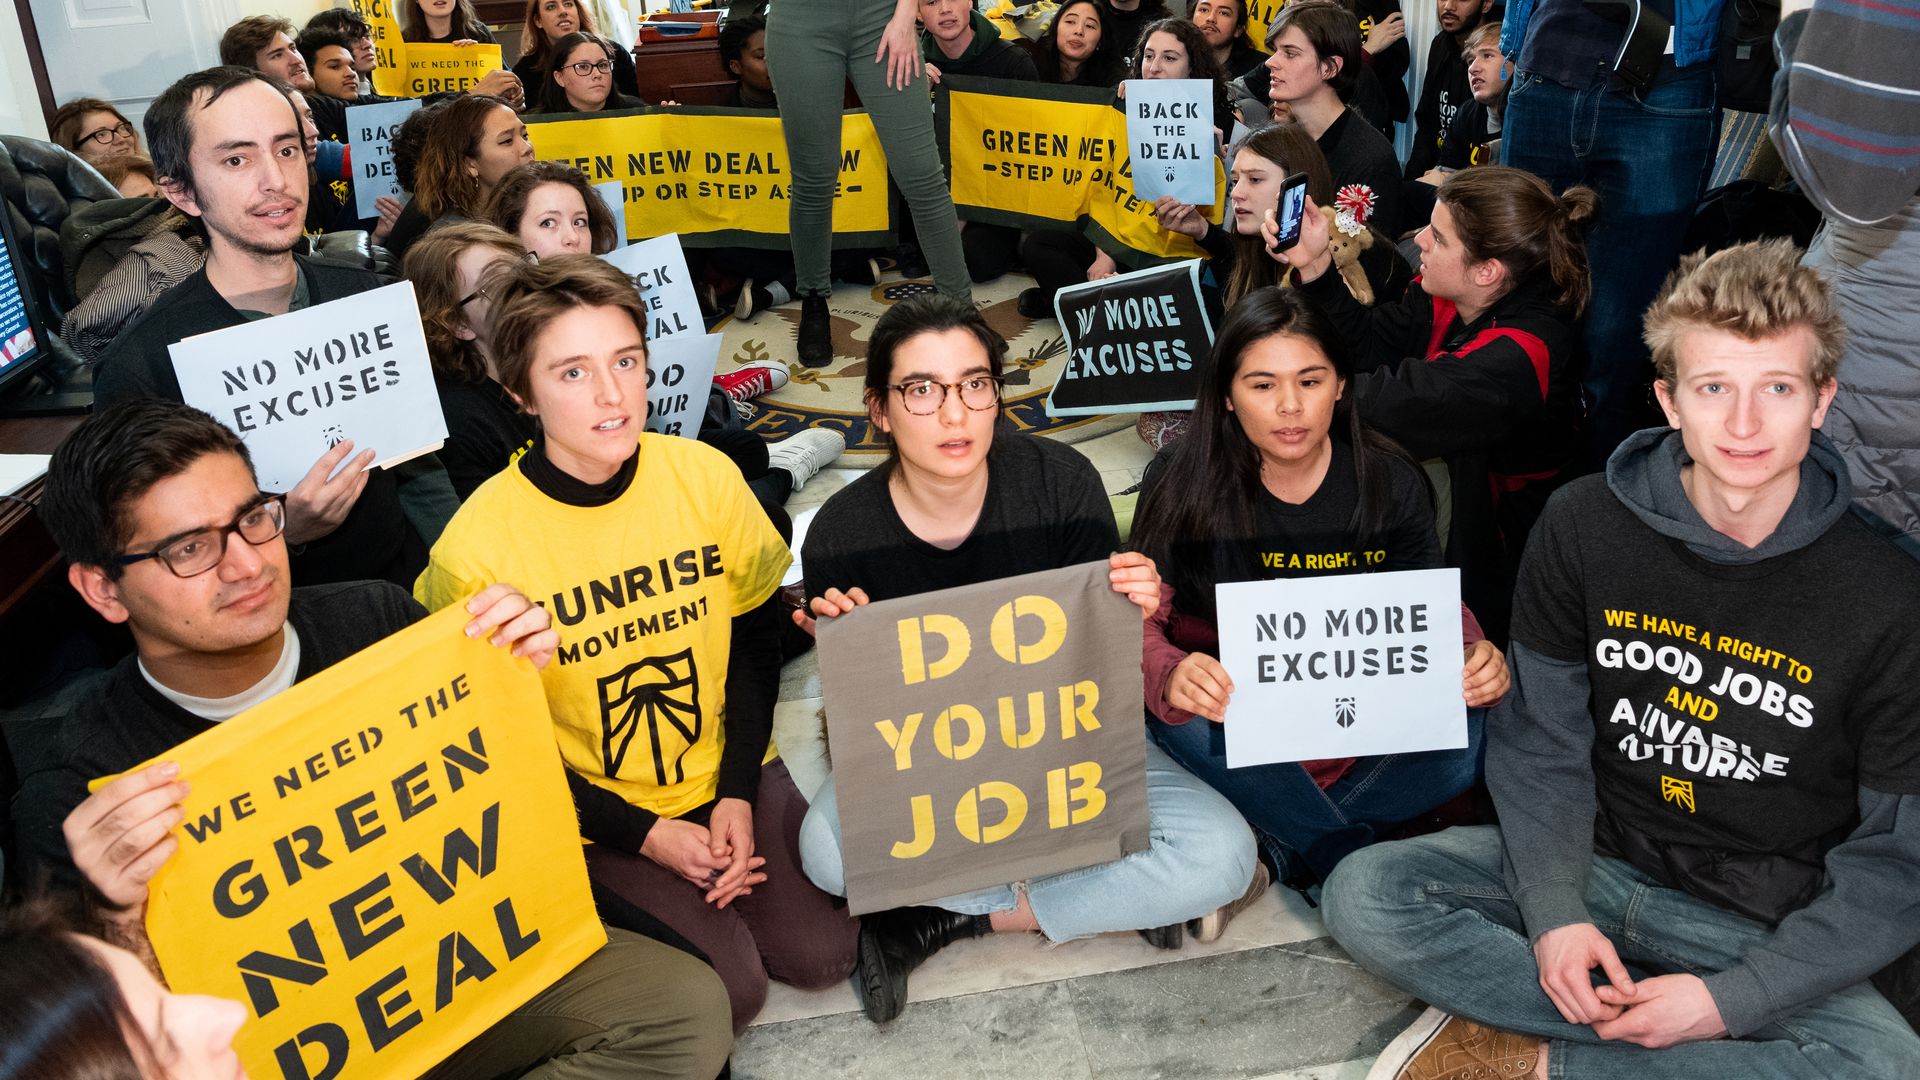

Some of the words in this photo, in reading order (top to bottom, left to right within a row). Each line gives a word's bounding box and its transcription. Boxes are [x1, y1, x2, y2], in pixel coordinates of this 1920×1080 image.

[411, 61, 427, 69] WE
[432, 61, 460, 69] NEED
[465, 60, 485, 68] THE
[1138, 102, 1199, 119] BACK
[361, 124, 400, 142] BAC
[982, 128, 1069, 158] GREEN
[1152, 125, 1186, 137] THE
[365, 161, 392, 179] DE
[628, 150, 692, 177] NEW
[705, 152, 781, 175] DEAL
[1140, 142, 1201, 160] DEAL
[655, 182, 688, 201] OR
[698, 181, 758, 200] STEP
[1063, 168, 1083, 186] UP
[1104, 294, 1182, 331] MORE
[221, 358, 277, 396] NO
[294, 323, 394, 376] MORE
[1065, 338, 1193, 380] EXCUSES
[233, 360, 401, 433] EXCUSES
[1287, 553, 1302, 569] A
[1363, 550, 1387, 566] TO
[535, 543, 725, 627] UNRISE
[557, 595, 708, 666] MOVEMENT
[896, 594, 1068, 685] DO
[1256, 611, 1307, 642] NO
[1325, 603, 1428, 638] MORE
[1257, 644, 1429, 684] EXCUSES
[1604, 609, 1638, 629] WE
[1642, 614, 1697, 642] HAVE
[1699, 631, 1712, 650] A
[1716, 635, 1787, 671] RIGHT
[1787, 658, 1813, 685] TO
[1595, 638, 1704, 685] GOOD
[1708, 665, 1815, 728] JOBS
[1609, 697, 1637, 726] A
[1663, 686, 1720, 722] AND
[873, 680, 1103, 771] YOUR
[183, 791, 257, 844] WE
[273, 726, 383, 799] NEED
[399, 673, 472, 729] THE
[212, 726, 490, 919] GREEN
[889, 761, 1107, 860] JOB
[236, 801, 501, 1019] NEW
[273, 896, 541, 1080] DEAL
